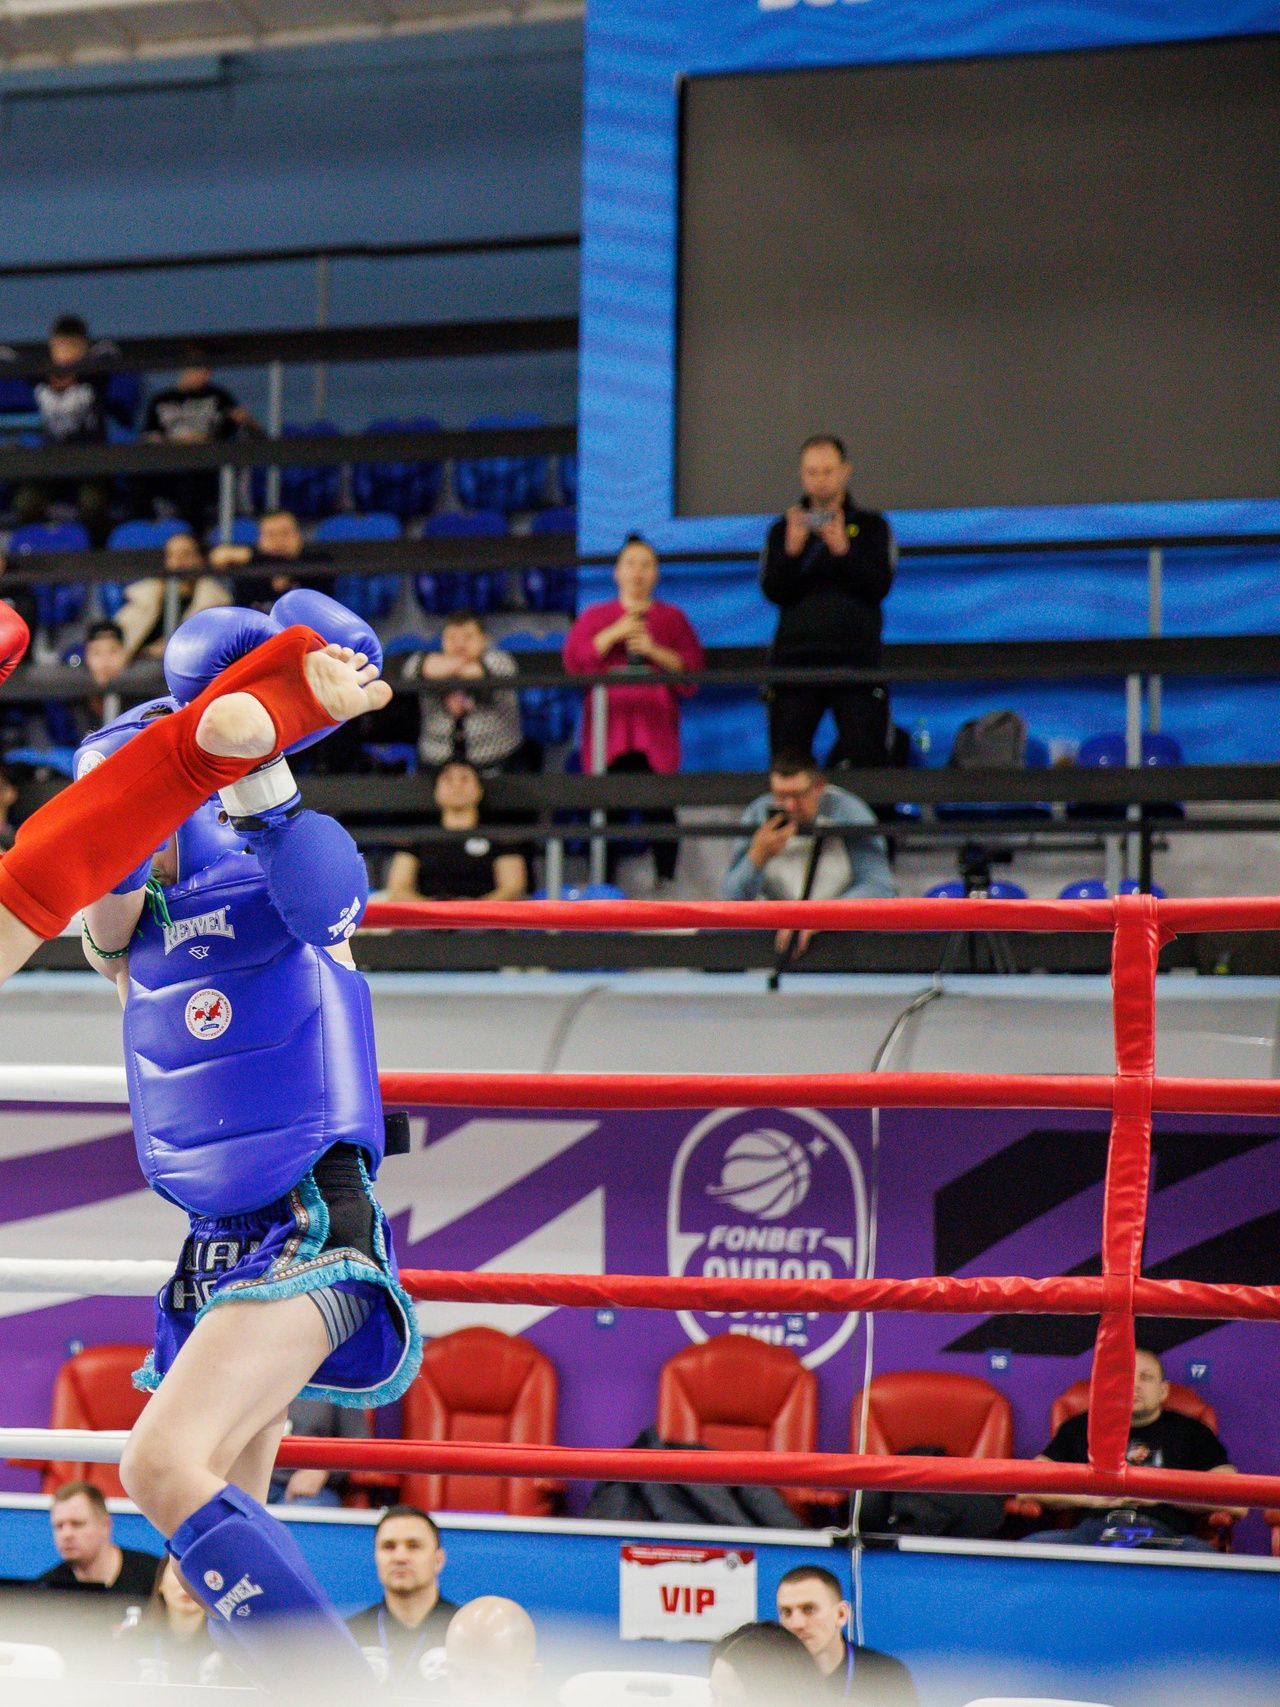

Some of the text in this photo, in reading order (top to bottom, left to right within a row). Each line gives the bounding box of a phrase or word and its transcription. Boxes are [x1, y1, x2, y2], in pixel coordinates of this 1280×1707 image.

[162, 907, 236, 956] REYVEL
[706, 1225, 825, 1253] FONBET
[1191, 1364, 1207, 1378] 17
[661, 1586, 715, 1614] VIP
